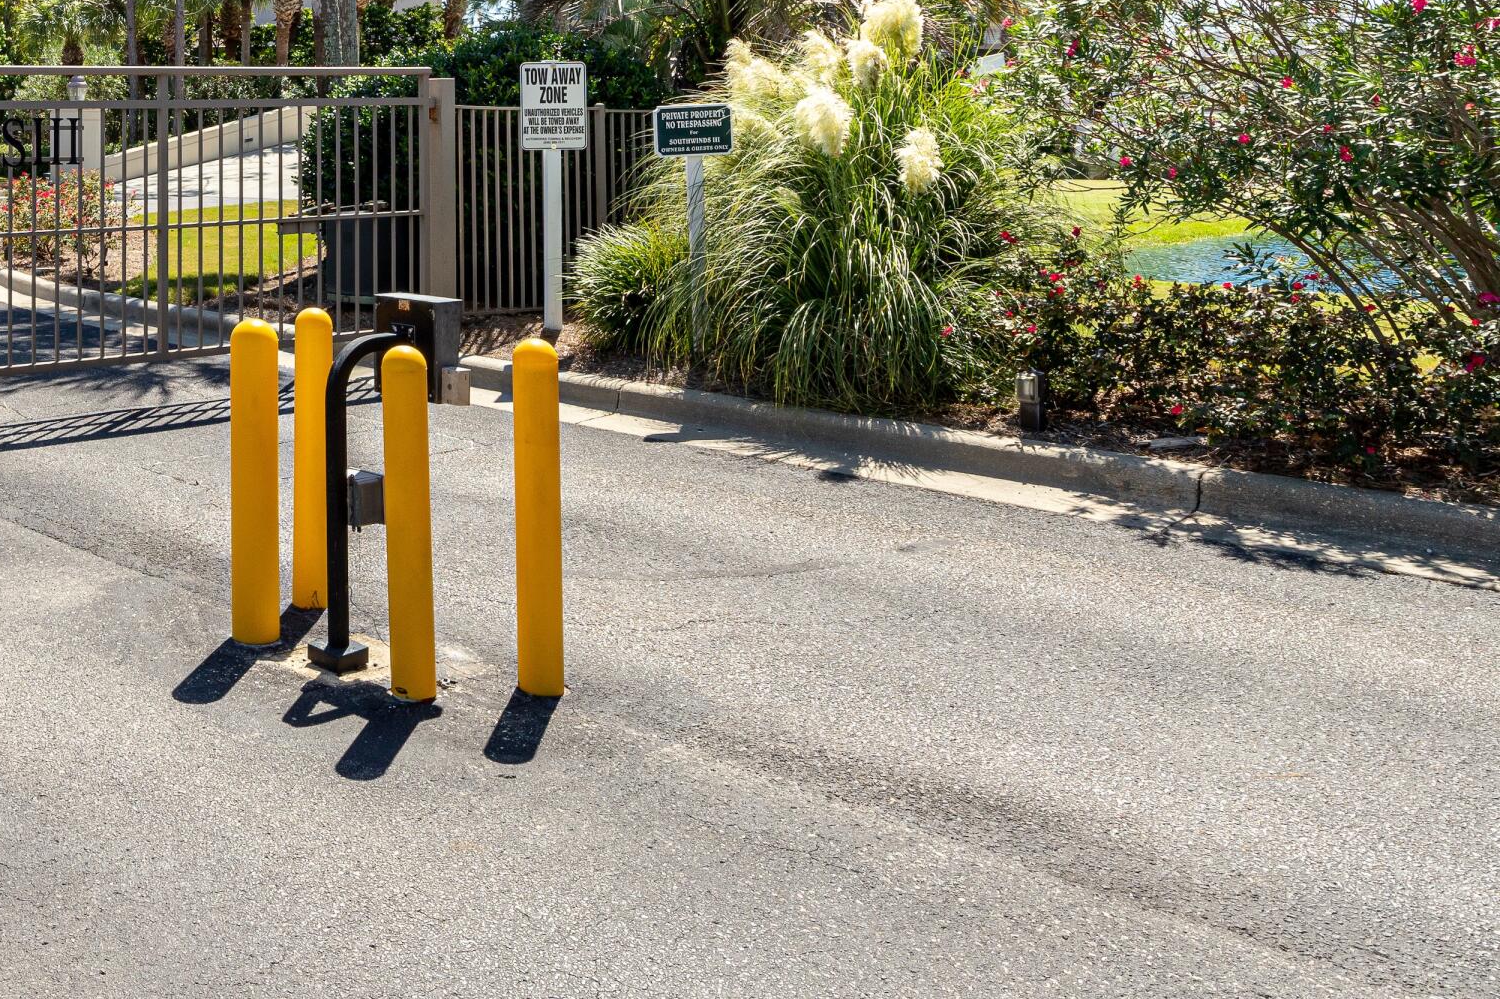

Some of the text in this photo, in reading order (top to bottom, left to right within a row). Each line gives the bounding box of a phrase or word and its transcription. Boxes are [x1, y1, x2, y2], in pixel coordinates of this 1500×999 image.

[525, 68, 581, 85] TOW AWAY
[539, 86, 568, 104] ZONE
[524, 107, 584, 117] UNAUTHORIZED VEHICLES
[661, 110, 726, 120] PRIVATE PROPERTY
[529, 117, 579, 126] WILL BE TOWED AWAY
[666, 119, 722, 129] NO TRESPASSING
[524, 125, 585, 135] AT THE OWNER'S EXPENSE
[669, 137, 711, 145] SOUTHWINDS
